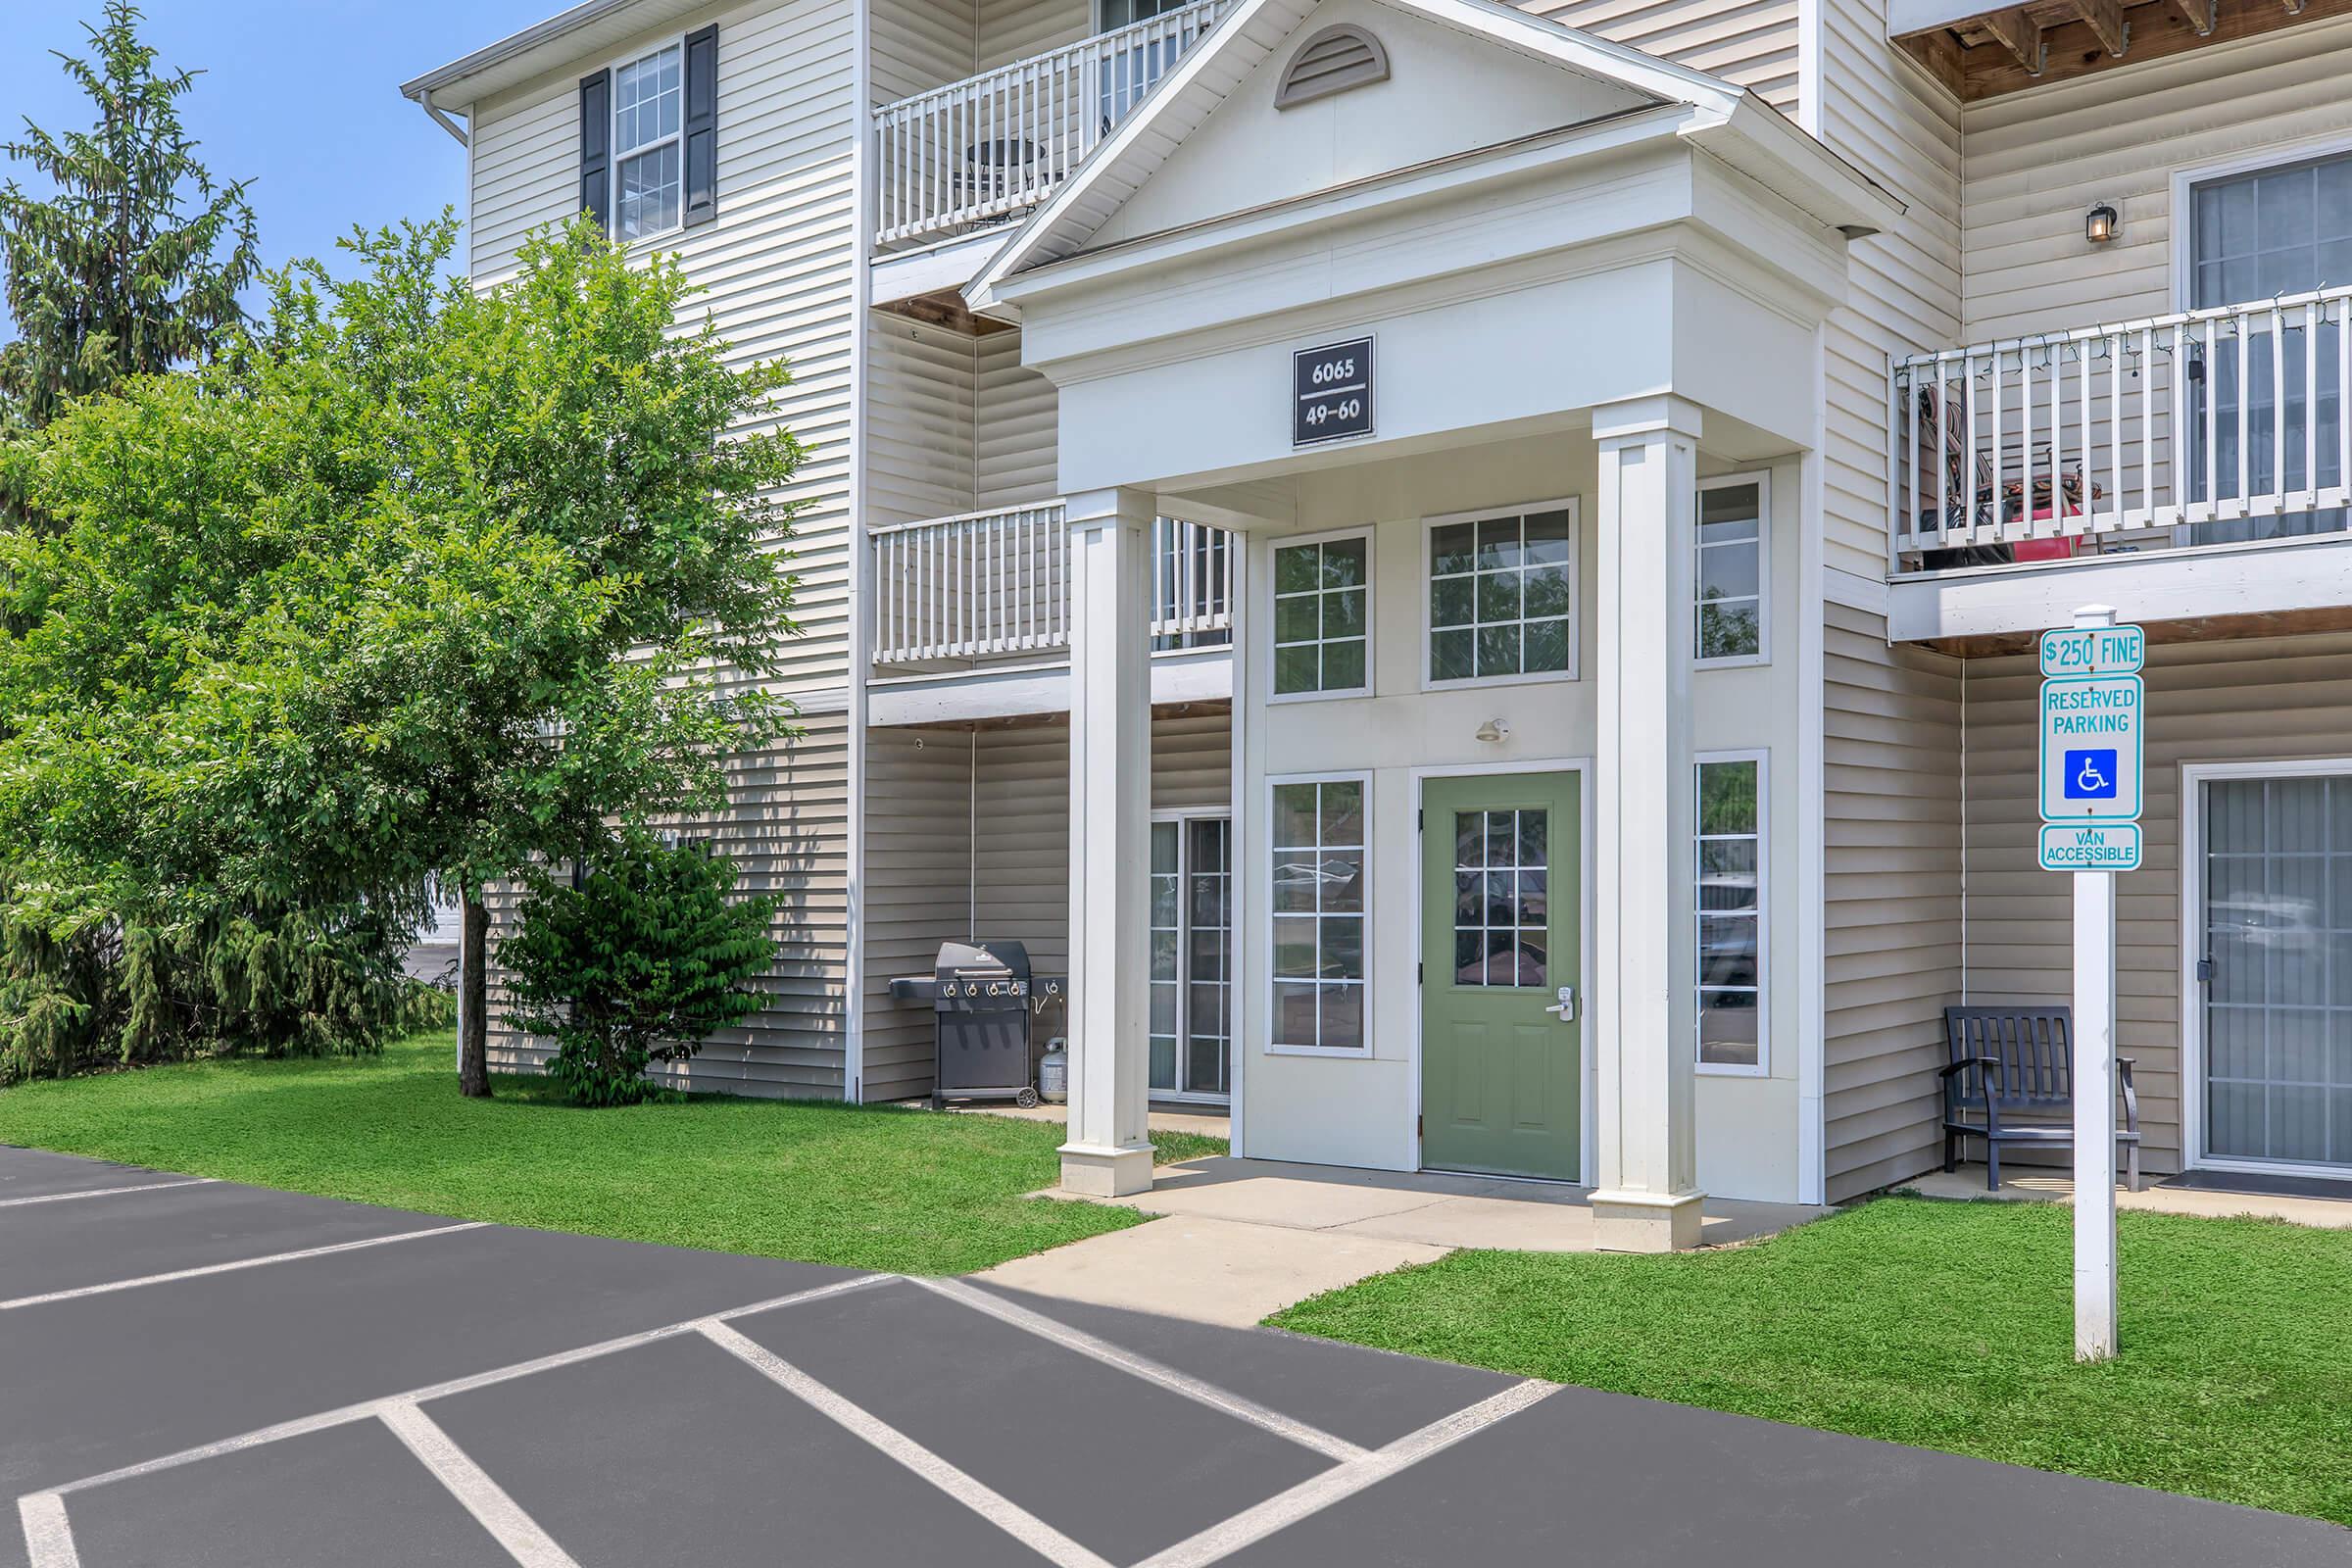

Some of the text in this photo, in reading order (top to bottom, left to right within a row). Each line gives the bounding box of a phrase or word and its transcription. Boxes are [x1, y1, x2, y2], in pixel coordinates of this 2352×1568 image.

[1312, 359, 1355, 384] 6065
[1305, 398, 1360, 425] 49-60
[2045, 636, 2139, 666] $250 FINE
[2048, 689, 2134, 710] RESERVED
[2053, 713, 2129, 735] PARKING
[2075, 832, 2105, 846] VAN
[2046, 847, 2134, 861] ACCESSIBLE
